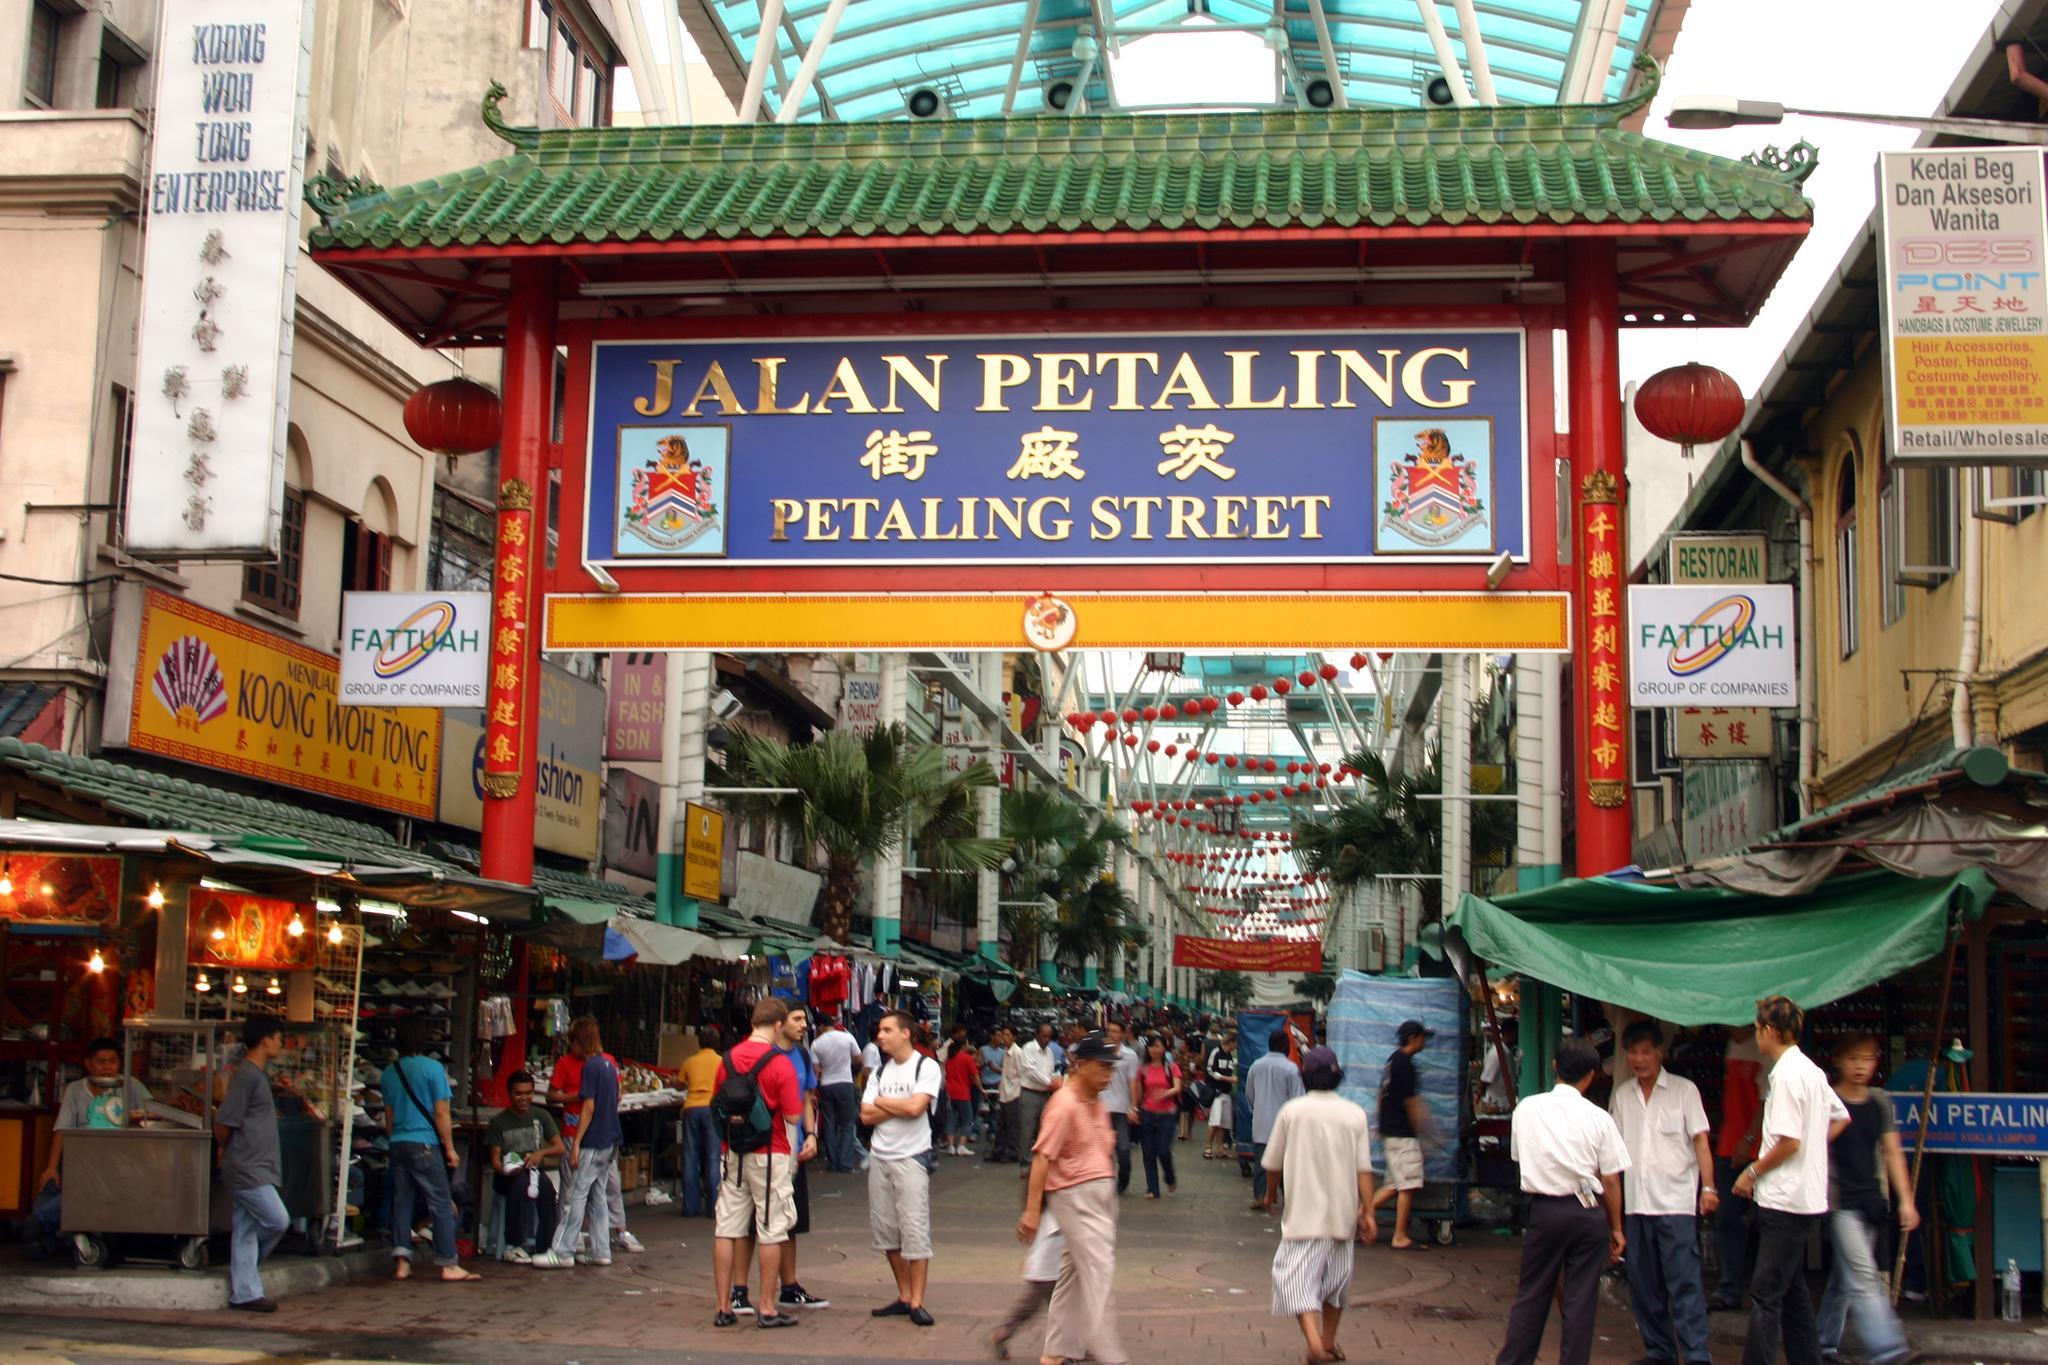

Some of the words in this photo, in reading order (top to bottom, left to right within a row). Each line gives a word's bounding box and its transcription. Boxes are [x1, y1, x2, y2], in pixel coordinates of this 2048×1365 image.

[192, 23, 266, 64] KOONG
[195, 122, 252, 163] TONG
[1910, 157, 1967, 180] Kedai
[1975, 156, 2014, 184] Beg
[152, 169, 286, 214] ENTERPRISE
[1896, 183, 1934, 206] Dan
[1942, 181, 2032, 206] Aksesori
[1930, 208, 2000, 231] Wanita
[1903, 240, 2033, 265] DES
[1912, 295, 2029, 314] 星天地
[1898, 317, 1943, 333] HANDBAGS
[1945, 319, 1950, 332] &
[1953, 317, 1993, 333] COSTUME
[1994, 316, 2043, 333] JEWELLERY
[1911, 341, 1939, 353] Hair
[633, 353, 949, 417] JALAN
[975, 347, 1477, 413] PETALING
[1906, 370, 1969, 382] Costume
[1902, 429, 2048, 447] Retail/Wholesale
[769, 495, 1074, 541] PETALING
[1090, 494, 1331, 541] STREET
[1679, 547, 1760, 579] RESTORAN
[351, 628, 479, 653] FATTUAH
[1641, 623, 1783, 650] FATTUAH
[344, 682, 388, 696] GROUP
[391, 683, 407, 696] OF
[410, 683, 481, 697] COMPANIES
[624, 673, 641, 697] IN
[651, 676, 663, 696] &
[1638, 681, 1686, 695] GROUP
[1689, 681, 1707, 695] OF
[1711, 682, 1788, 695] COMPANIES
[237, 668, 317, 739] KOONG
[325, 698, 376, 757] WOH
[382, 717, 429, 773] TONG
[614, 728, 650, 752] SDN
[1961, 1131, 1994, 1144] KUALA
[1998, 1131, 2038, 1144] LUMPUR
